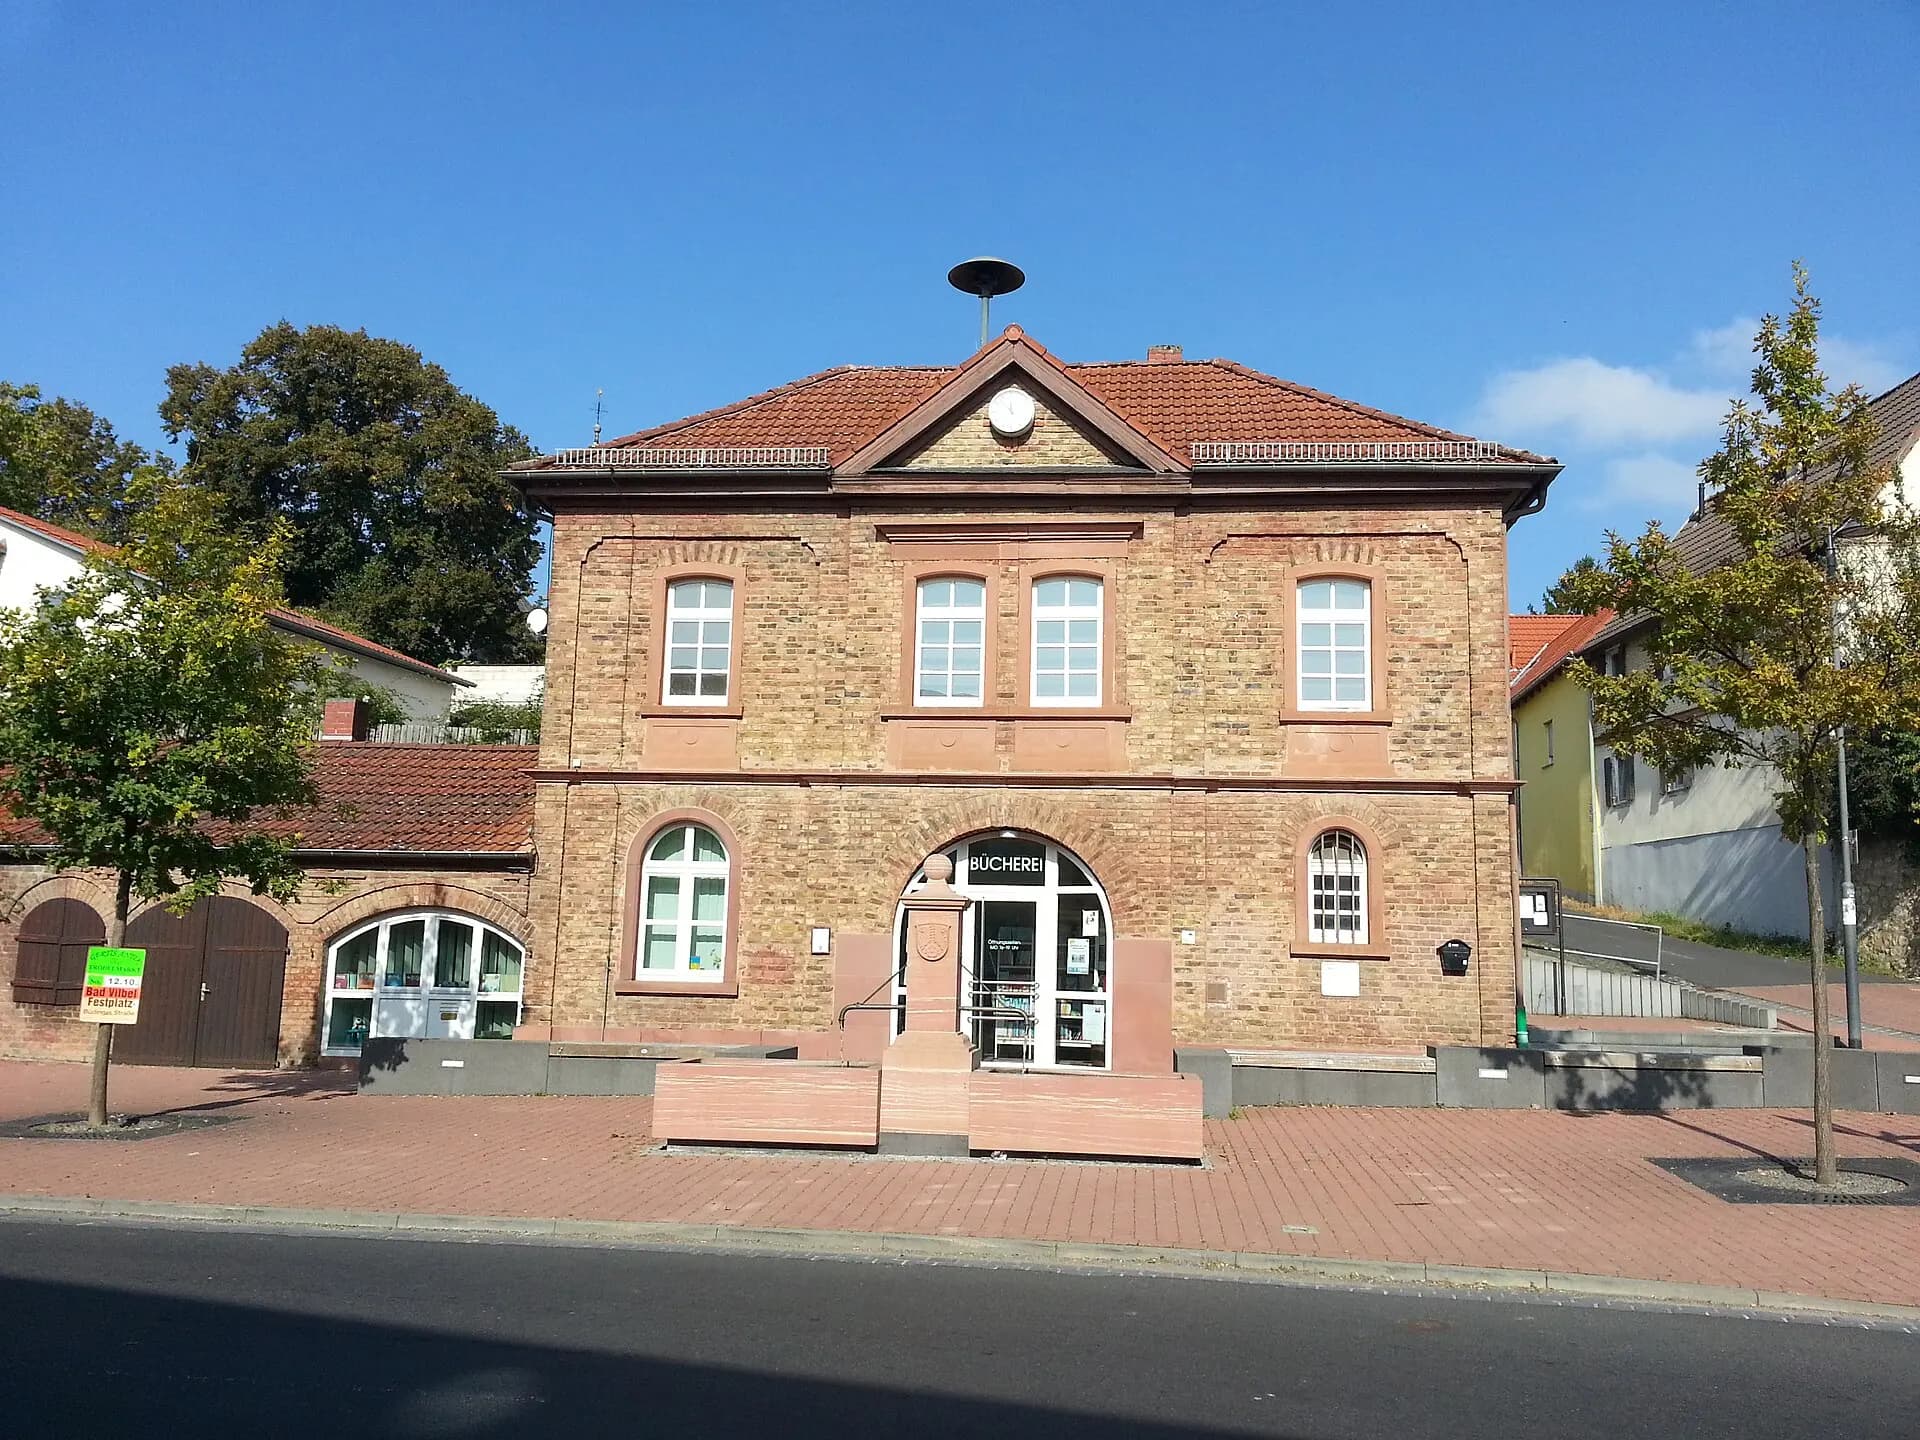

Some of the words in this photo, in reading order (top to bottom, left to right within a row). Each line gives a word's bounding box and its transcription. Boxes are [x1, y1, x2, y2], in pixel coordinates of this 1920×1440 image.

[970, 853, 1043, 872] BÜCHEREI
[86, 987, 105, 997] Bad
[109, 988, 137, 998] Vilbel
